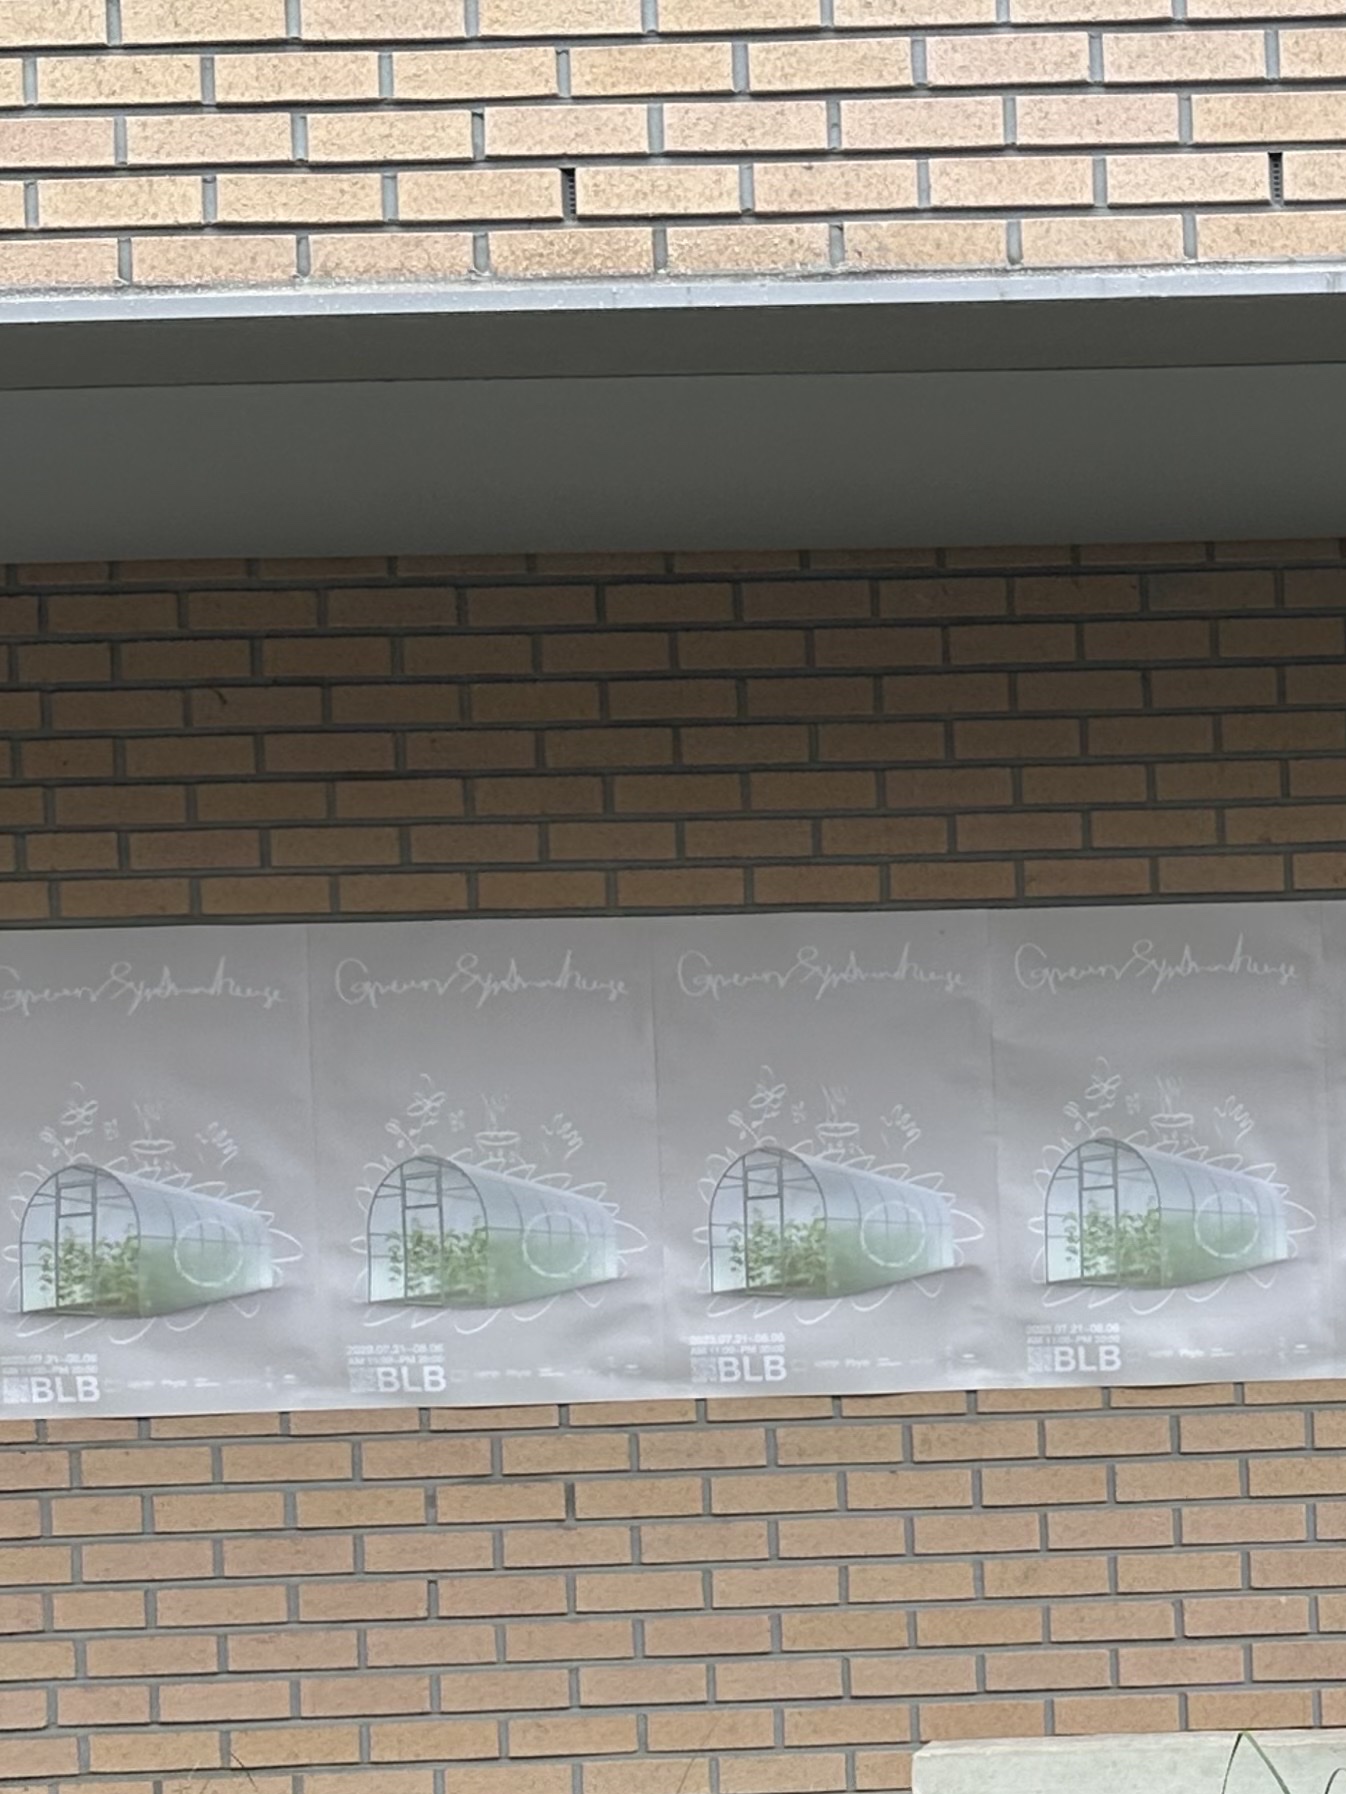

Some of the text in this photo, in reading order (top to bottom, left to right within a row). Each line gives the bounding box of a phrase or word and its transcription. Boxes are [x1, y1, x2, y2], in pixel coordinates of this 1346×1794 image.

[718, 1355, 787, 1382] BLB
[1053, 1345, 1122, 1372] BLB
[30, 1375, 100, 1403] BLB
[376, 1365, 447, 1392] BLB
